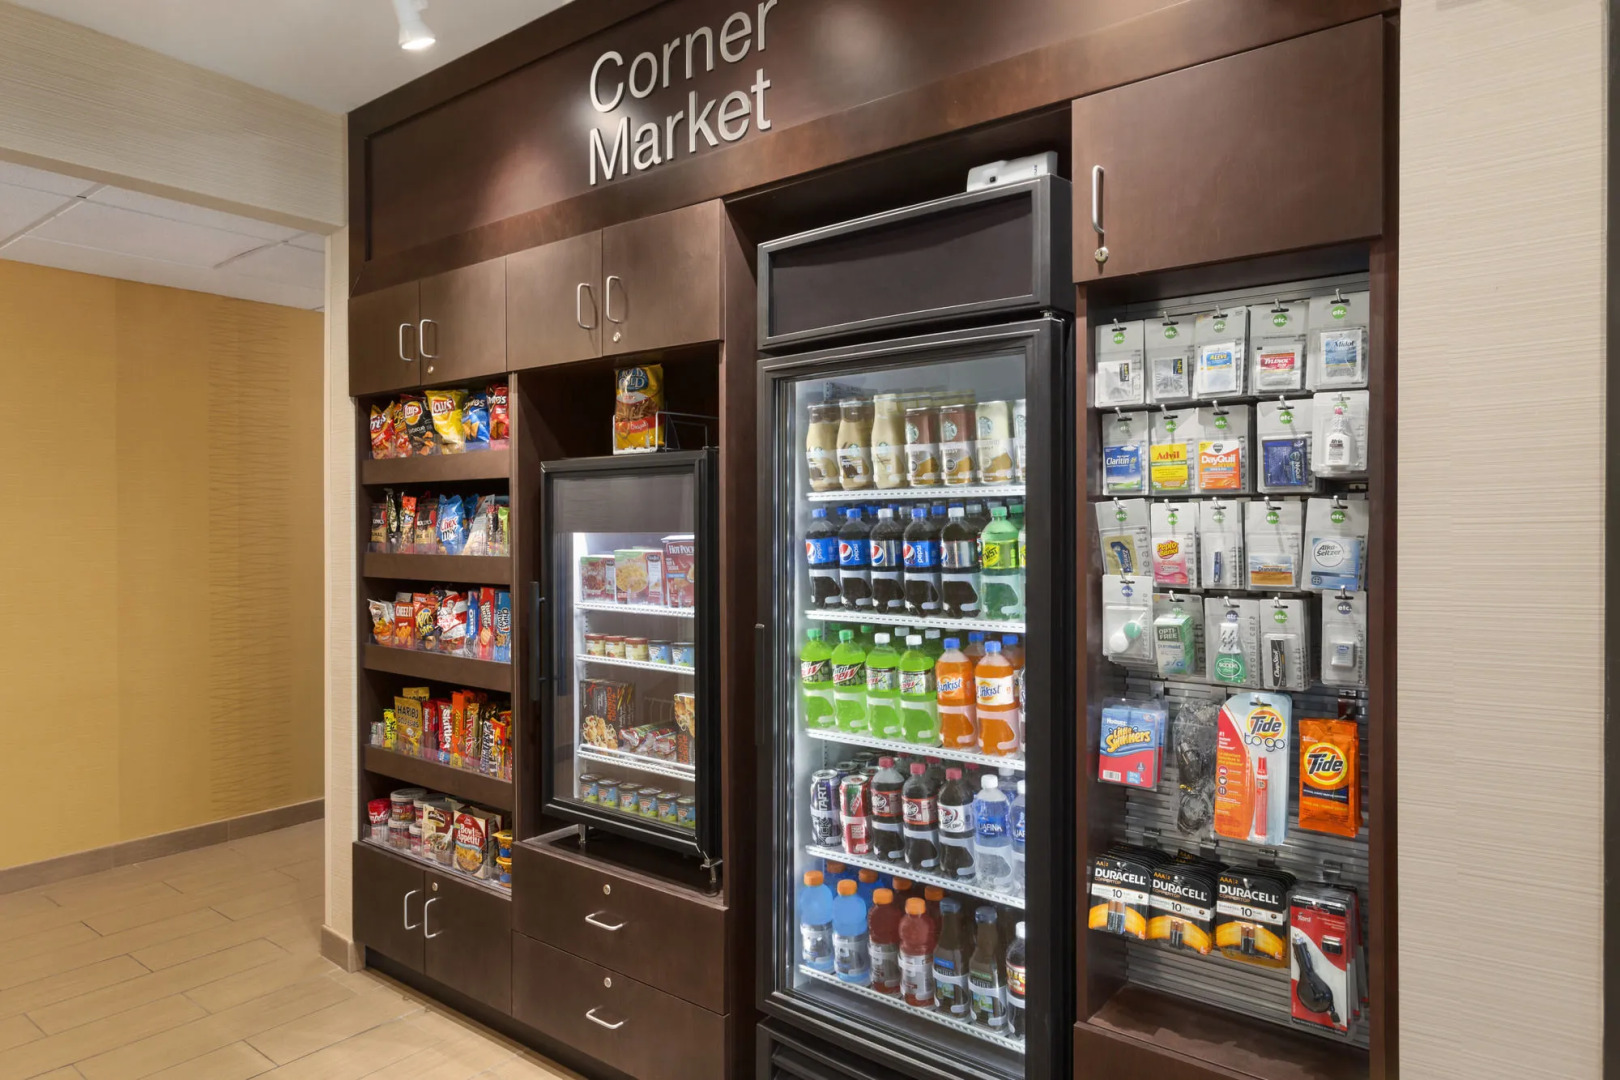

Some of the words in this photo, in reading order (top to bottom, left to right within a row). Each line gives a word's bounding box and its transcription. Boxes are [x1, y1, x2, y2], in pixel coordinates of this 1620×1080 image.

[590, 0, 777, 113] Corner
[590, 68, 772, 186] Market
[1106, 457, 1129, 465] Claritin
[1156, 451, 1180, 460] Advil
[1201, 453, 1236, 465] DayQuil
[1159, 632, 1179, 640] FREE
[1250, 715, 1282, 735] Tide
[1244, 732, 1263, 746] to
[1265, 737, 1286, 753] go
[1308, 752, 1344, 775] Tide
[1094, 867, 1147, 885] DURACELL
[1112, 888, 1123, 899] 10
[1152, 878, 1207, 902] DURACELL
[1219, 884, 1279, 905] DURACELL
[1171, 902, 1182, 913] 10
[1240, 907, 1253, 917] 10
